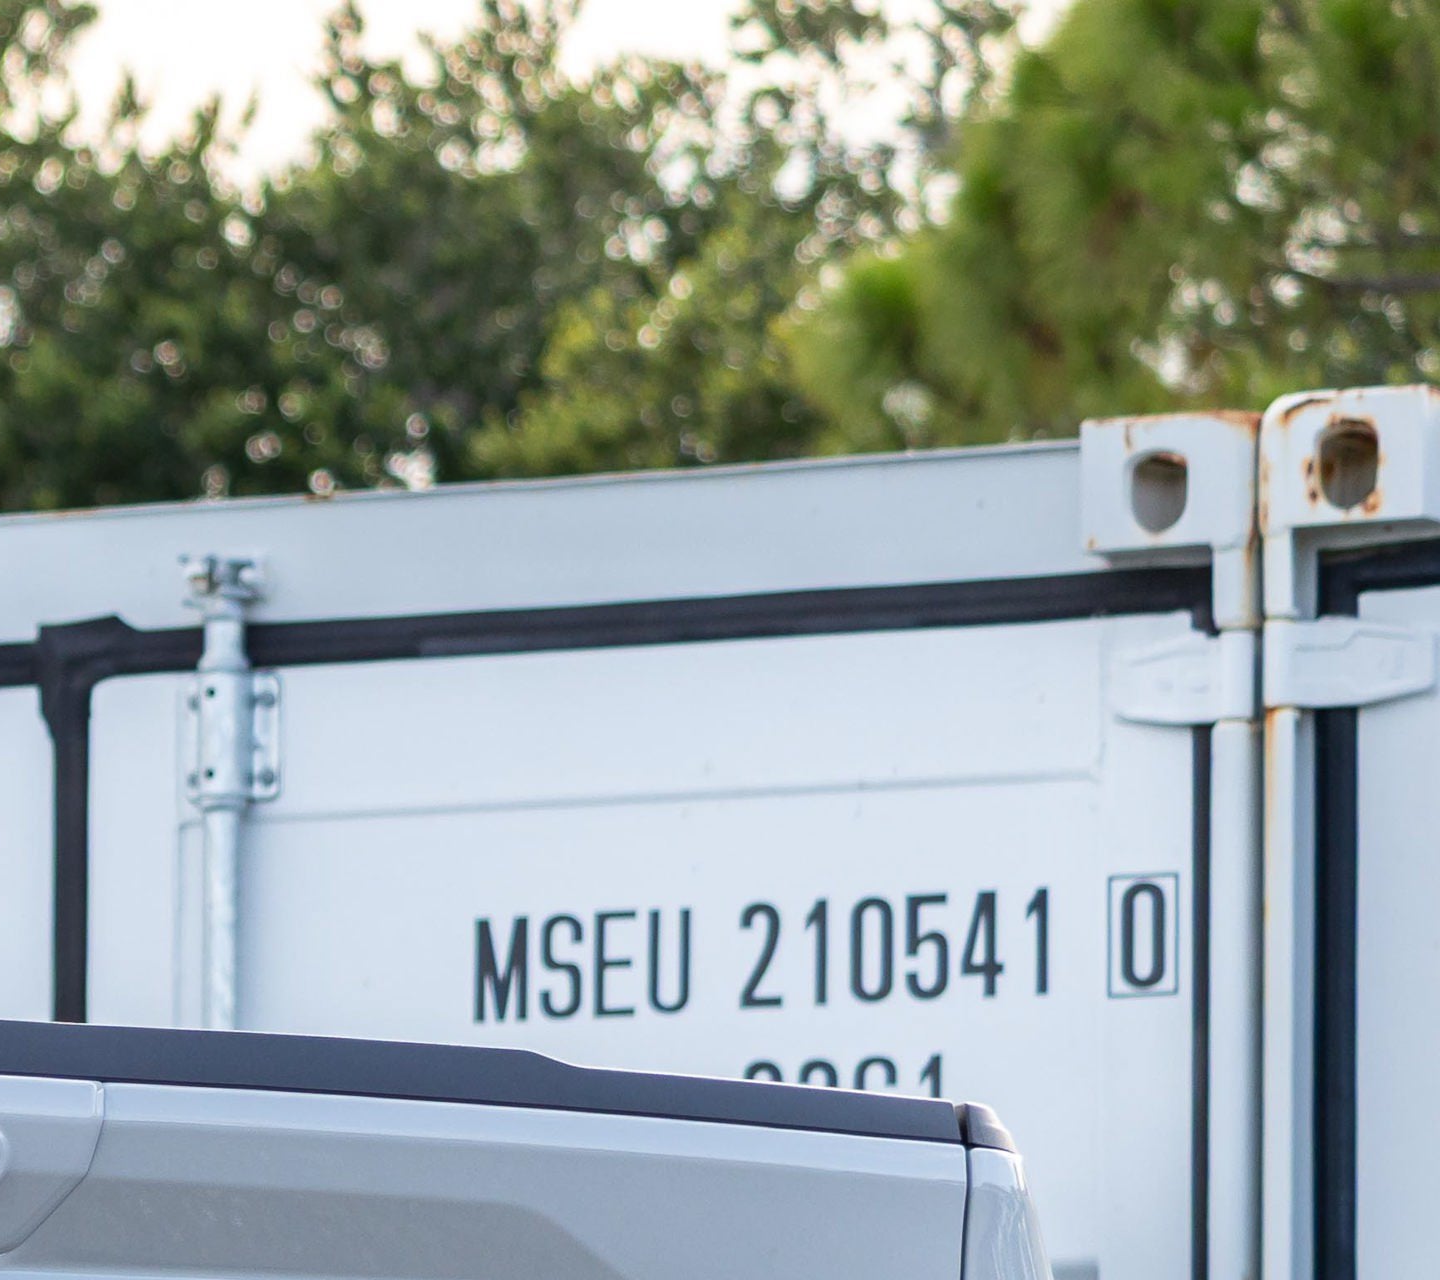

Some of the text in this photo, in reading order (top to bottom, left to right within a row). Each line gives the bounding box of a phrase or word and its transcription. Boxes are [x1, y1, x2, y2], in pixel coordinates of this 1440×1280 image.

[473, 880, 1169, 1023] MSEU 210541 0
